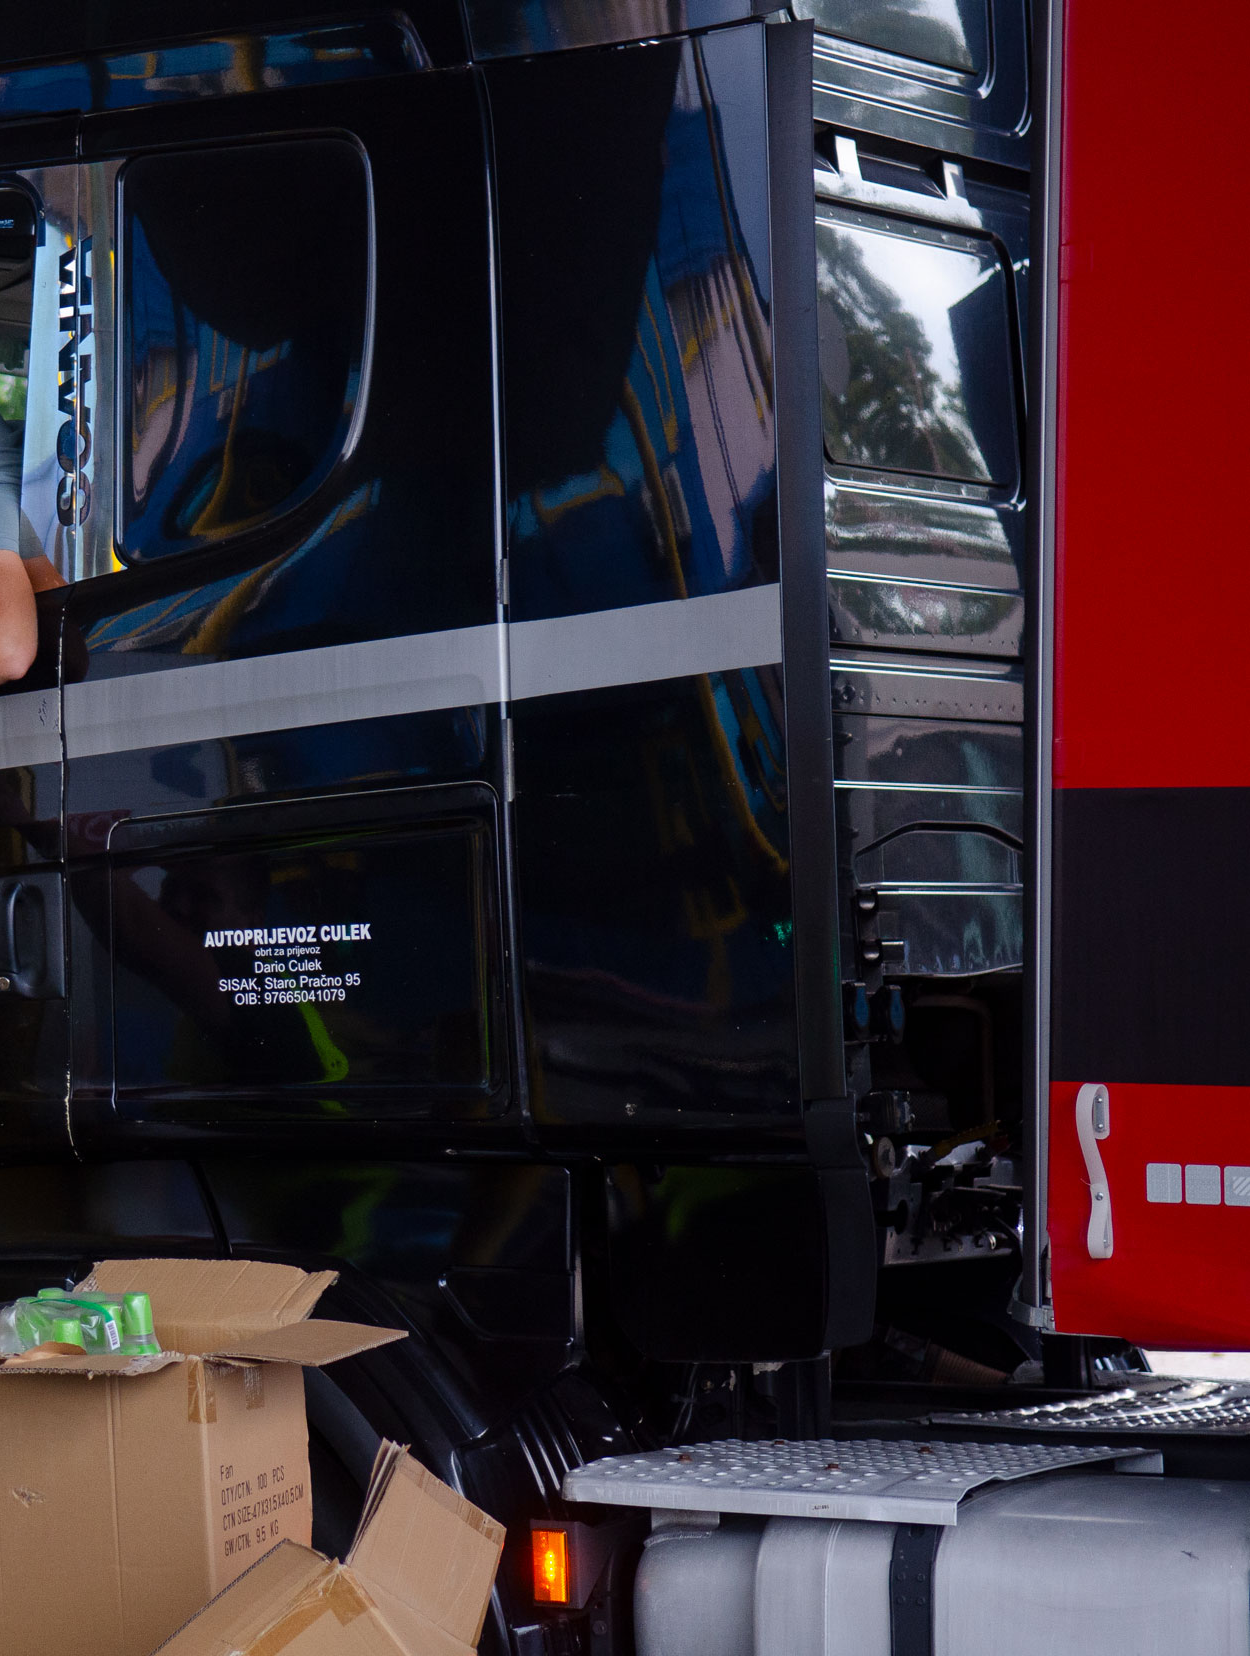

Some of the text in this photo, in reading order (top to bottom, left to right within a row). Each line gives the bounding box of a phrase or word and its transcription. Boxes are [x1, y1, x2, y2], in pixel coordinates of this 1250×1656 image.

[56, 235, 93, 527] SCANIA
[204, 923, 372, 948] AUTOPRIJEVOZ CULEK
[255, 945, 321, 957] obrt za prijevoz
[254, 958, 322, 974] Dario Culek
[219, 973, 361, 992] SISAK, Staro Pračno 95
[234, 988, 346, 1006] OIB: 97665041079
[220, 1465, 234, 1480] Fan
[221, 1465, 285, 1506] QTY/CTN: 100 PCS
[223, 1512, 236, 1531] CTN
[270, 1519, 280, 1537] KG
